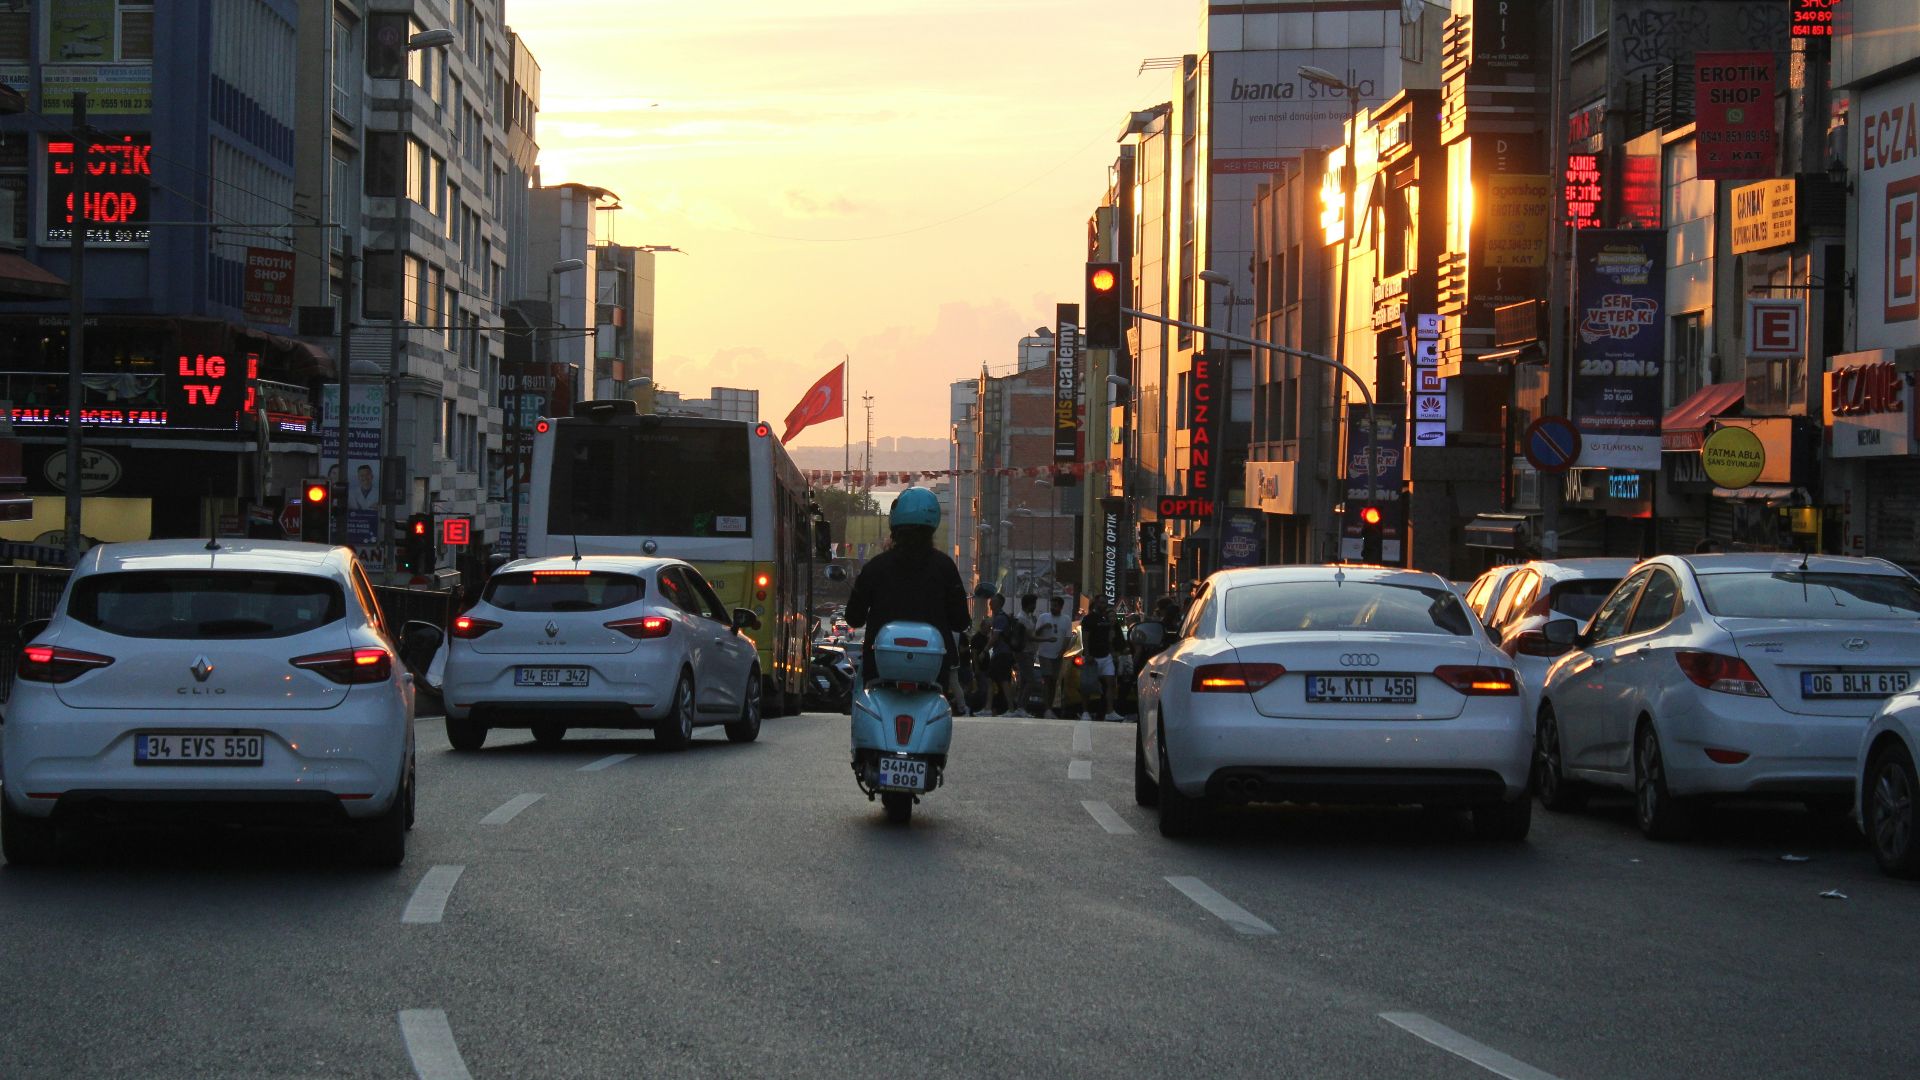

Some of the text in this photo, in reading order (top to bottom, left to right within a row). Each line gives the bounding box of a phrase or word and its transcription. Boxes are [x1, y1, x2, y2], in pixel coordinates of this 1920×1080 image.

[1701, 64, 1769, 82] EROTİK
[1231, 78, 1294, 100] bianca
[1710, 88, 1761, 104] SHOP
[1249, 112, 1267, 124] yeni
[1269, 112, 1288, 122] nesil
[1864, 103, 1920, 171] ECZA
[1732, 152, 1762, 160] KAT
[1894, 201, 1914, 299] E
[254, 269, 287, 280] SHOP
[1604, 296, 1632, 308] SEN
[1590, 310, 1635, 322] YETER
[1611, 324, 1638, 337] YAP
[1763, 312, 1790, 346] E
[178, 353, 227, 379] LİG
[1579, 359, 1615, 376] 220
[1056, 322, 1078, 430] ydsacademy
[181, 384, 222, 406] TV
[1193, 361, 1210, 489] ECZANE
[356, 430, 380, 440] Yakın
[323, 440, 379, 449] Labatuvar
[1708, 448, 1760, 460] FATMA ABLA
[1726, 460, 1760, 468] OYUNLARI
[1160, 497, 1214, 516] OPTİK
[449, 523, 463, 541] E
[523, 670, 586, 681] 34 EGT 342
[1813, 675, 1907, 692] 06 BLH 615
[177, 687, 227, 695] CLIO
[1317, 677, 1414, 696] 34 KTT 456
[149, 738, 259, 758] 34 EVS 550
[881, 759, 925, 775] 34HAC
[892, 773, 918, 786] 808
